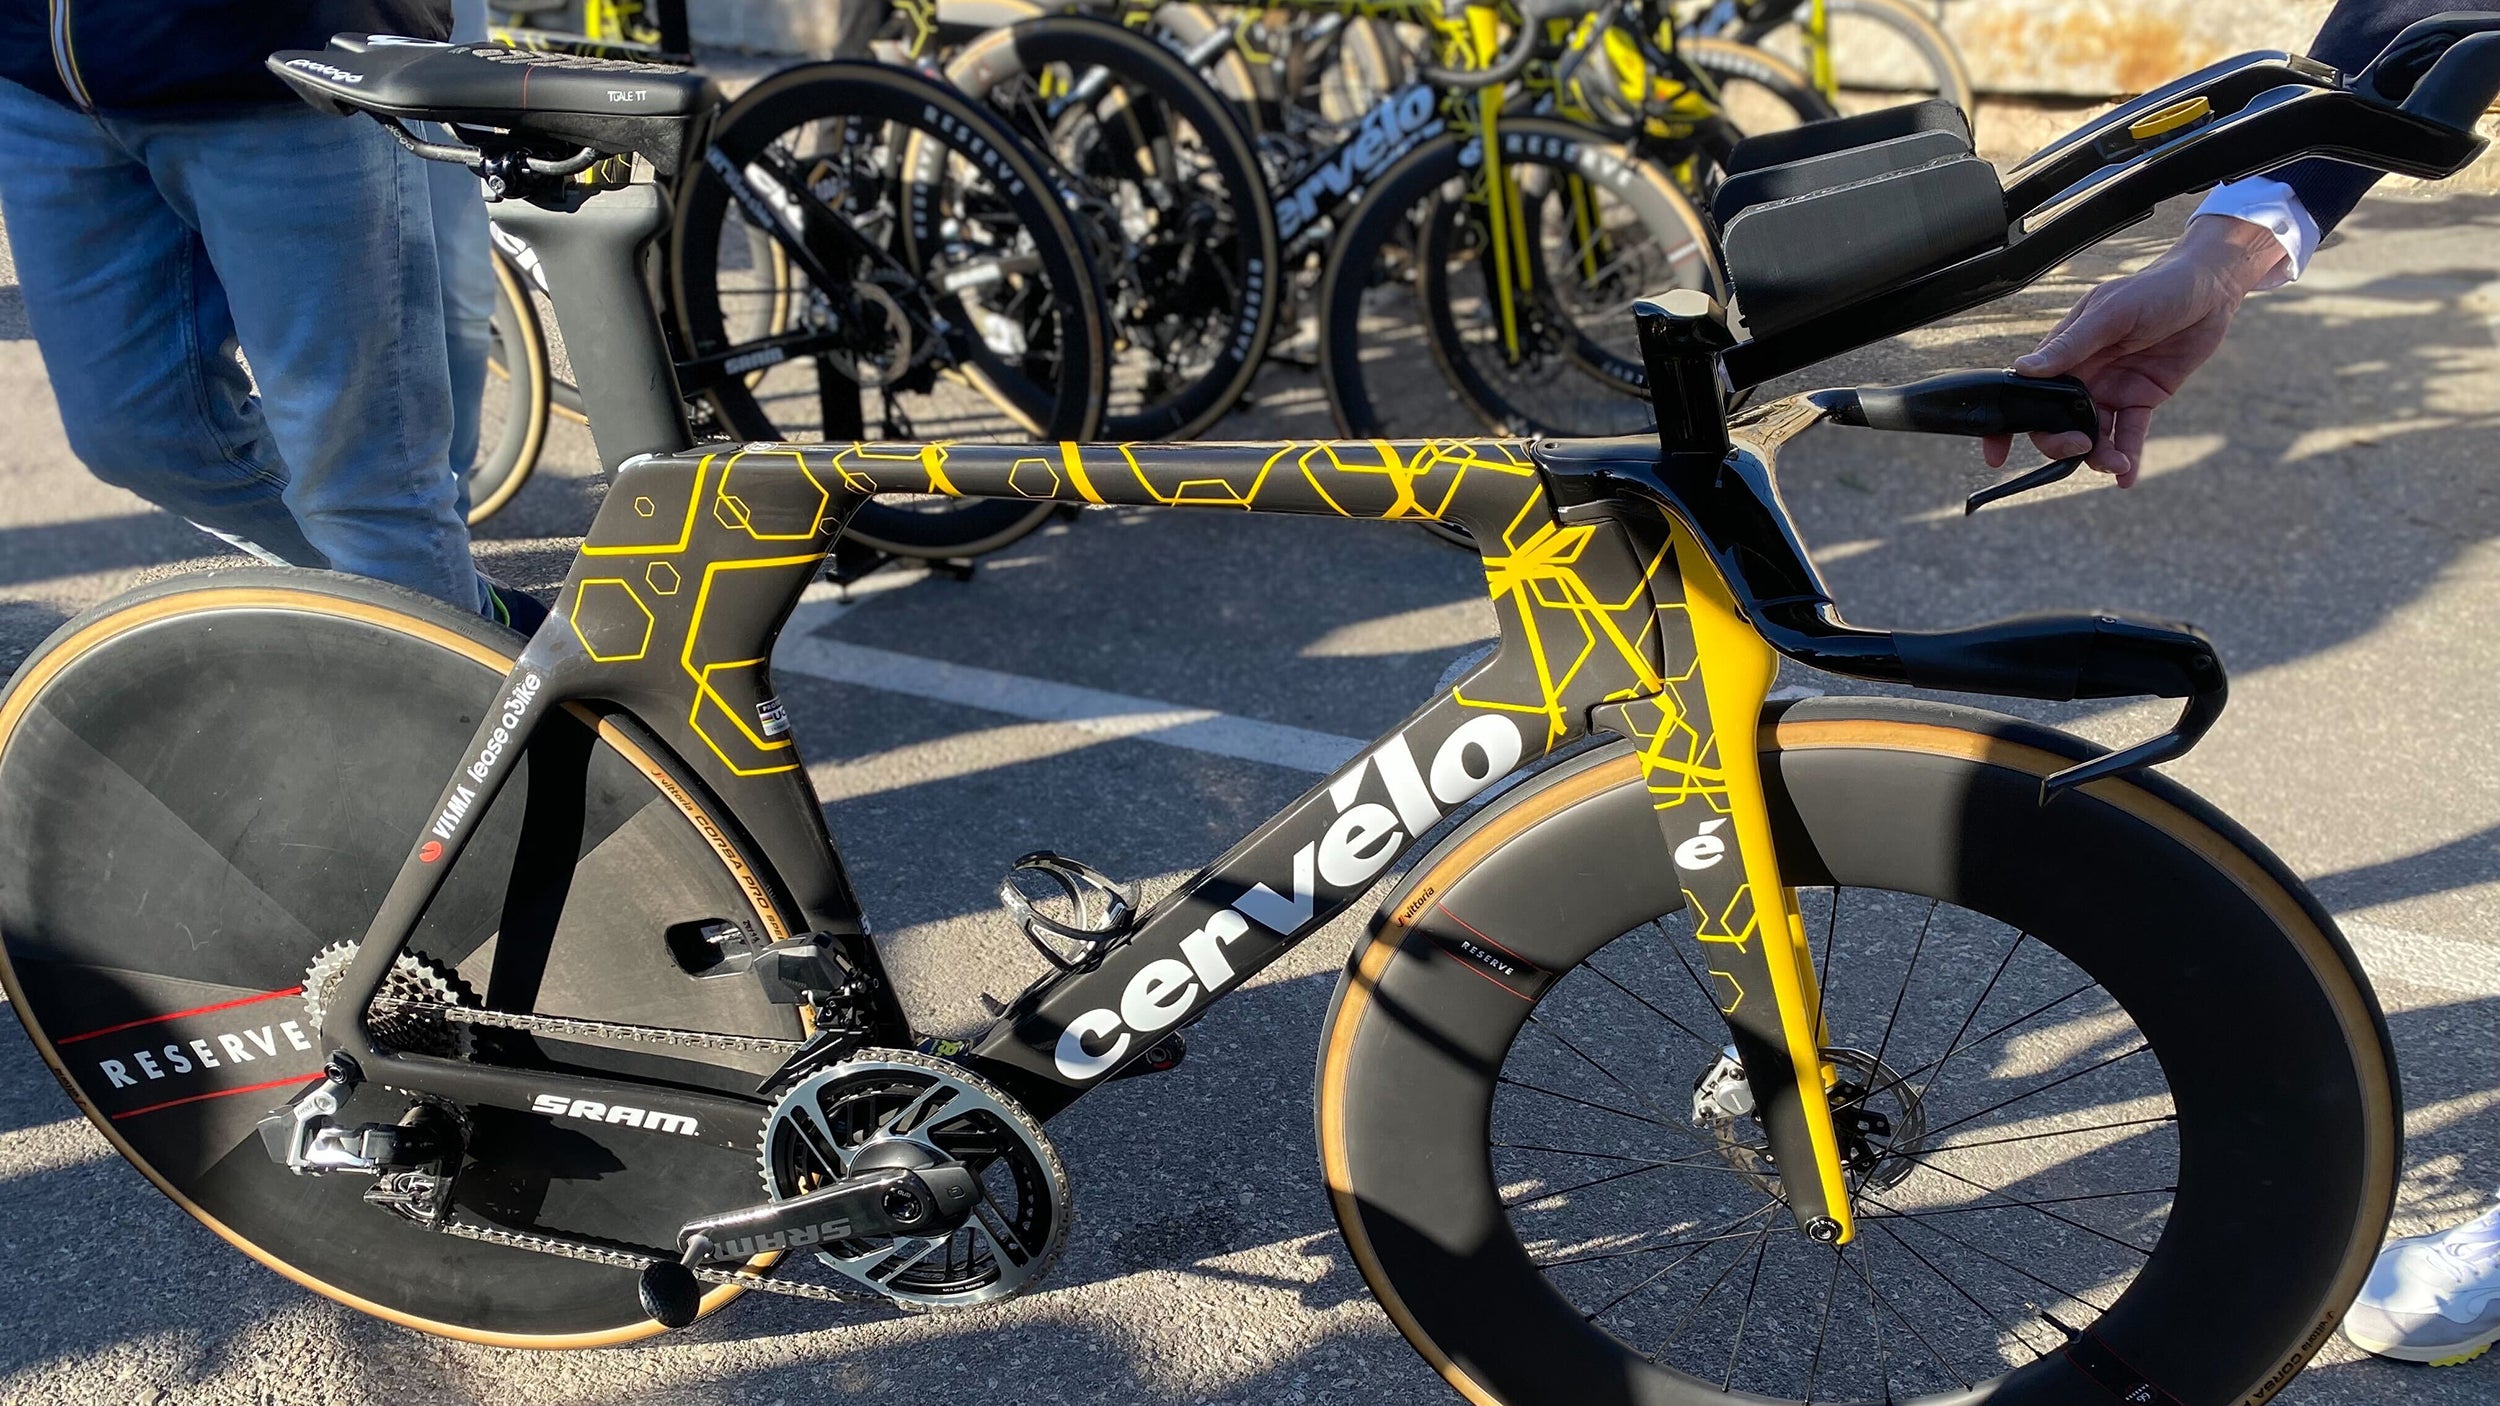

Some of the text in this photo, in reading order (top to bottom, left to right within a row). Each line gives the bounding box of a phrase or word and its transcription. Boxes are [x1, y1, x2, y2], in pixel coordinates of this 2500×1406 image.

[635, 90, 647, 101] TT
[923, 104, 1025, 196] RESERVE
[1275, 84, 1435, 240] ervélo
[1505, 133, 1634, 187] RESERVE
[432, 783, 476, 840] VISMA
[661, 778, 693, 812] vittoria
[694, 815, 743, 870] CORSA
[742, 875, 769, 909] PRO
[766, 914, 785, 941] SPE
[1674, 817, 1727, 870] é
[1054, 713, 1522, 1080] cervélo
[1405, 886, 1435, 920] vittoria
[1461, 940, 1514, 976] RESERVE
[100, 1020, 312, 1089] RESERVE
[532, 1094, 700, 1137] SRAM
[713, 1217, 852, 1262] SRAM
[2253, 1320, 2328, 1399] vittoria CORSA
